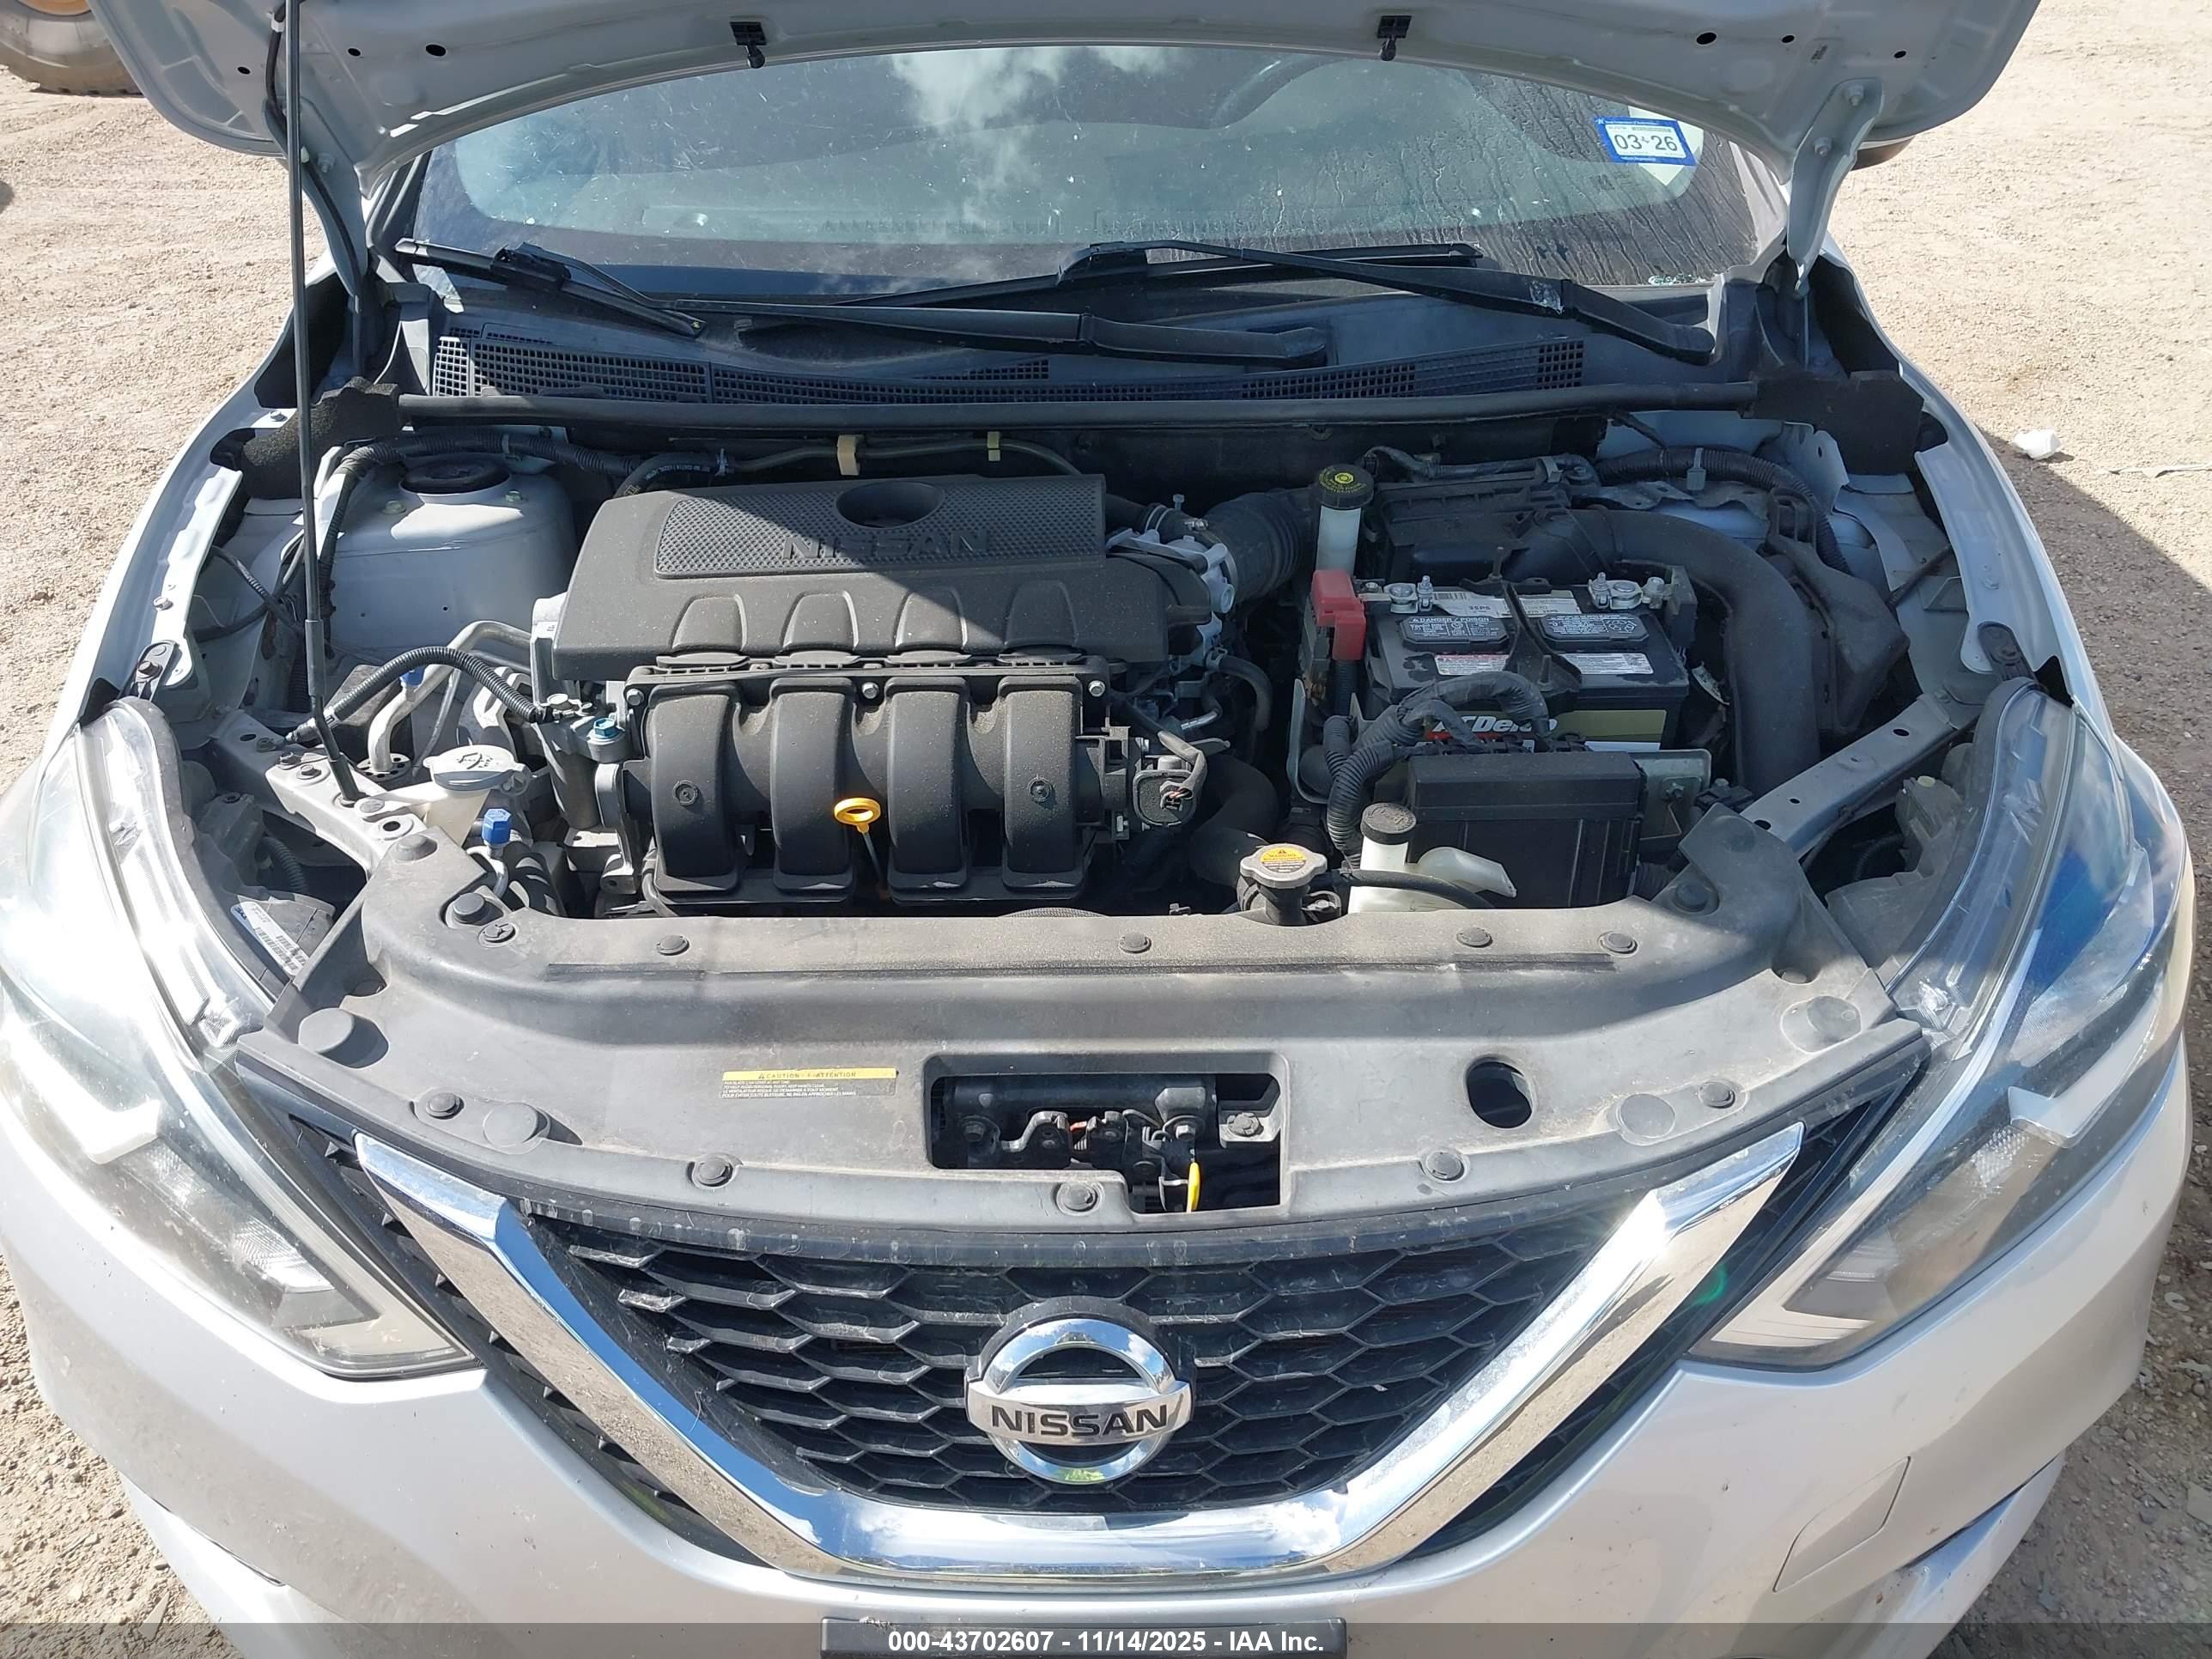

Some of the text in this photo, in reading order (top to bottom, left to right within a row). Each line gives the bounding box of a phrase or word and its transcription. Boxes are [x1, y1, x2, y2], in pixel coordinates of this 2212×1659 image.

[1613, 134, 1678, 151] 03 26
[781, 530, 988, 559] NISSAN
[992, 1405, 1167, 1436] NISSAN
